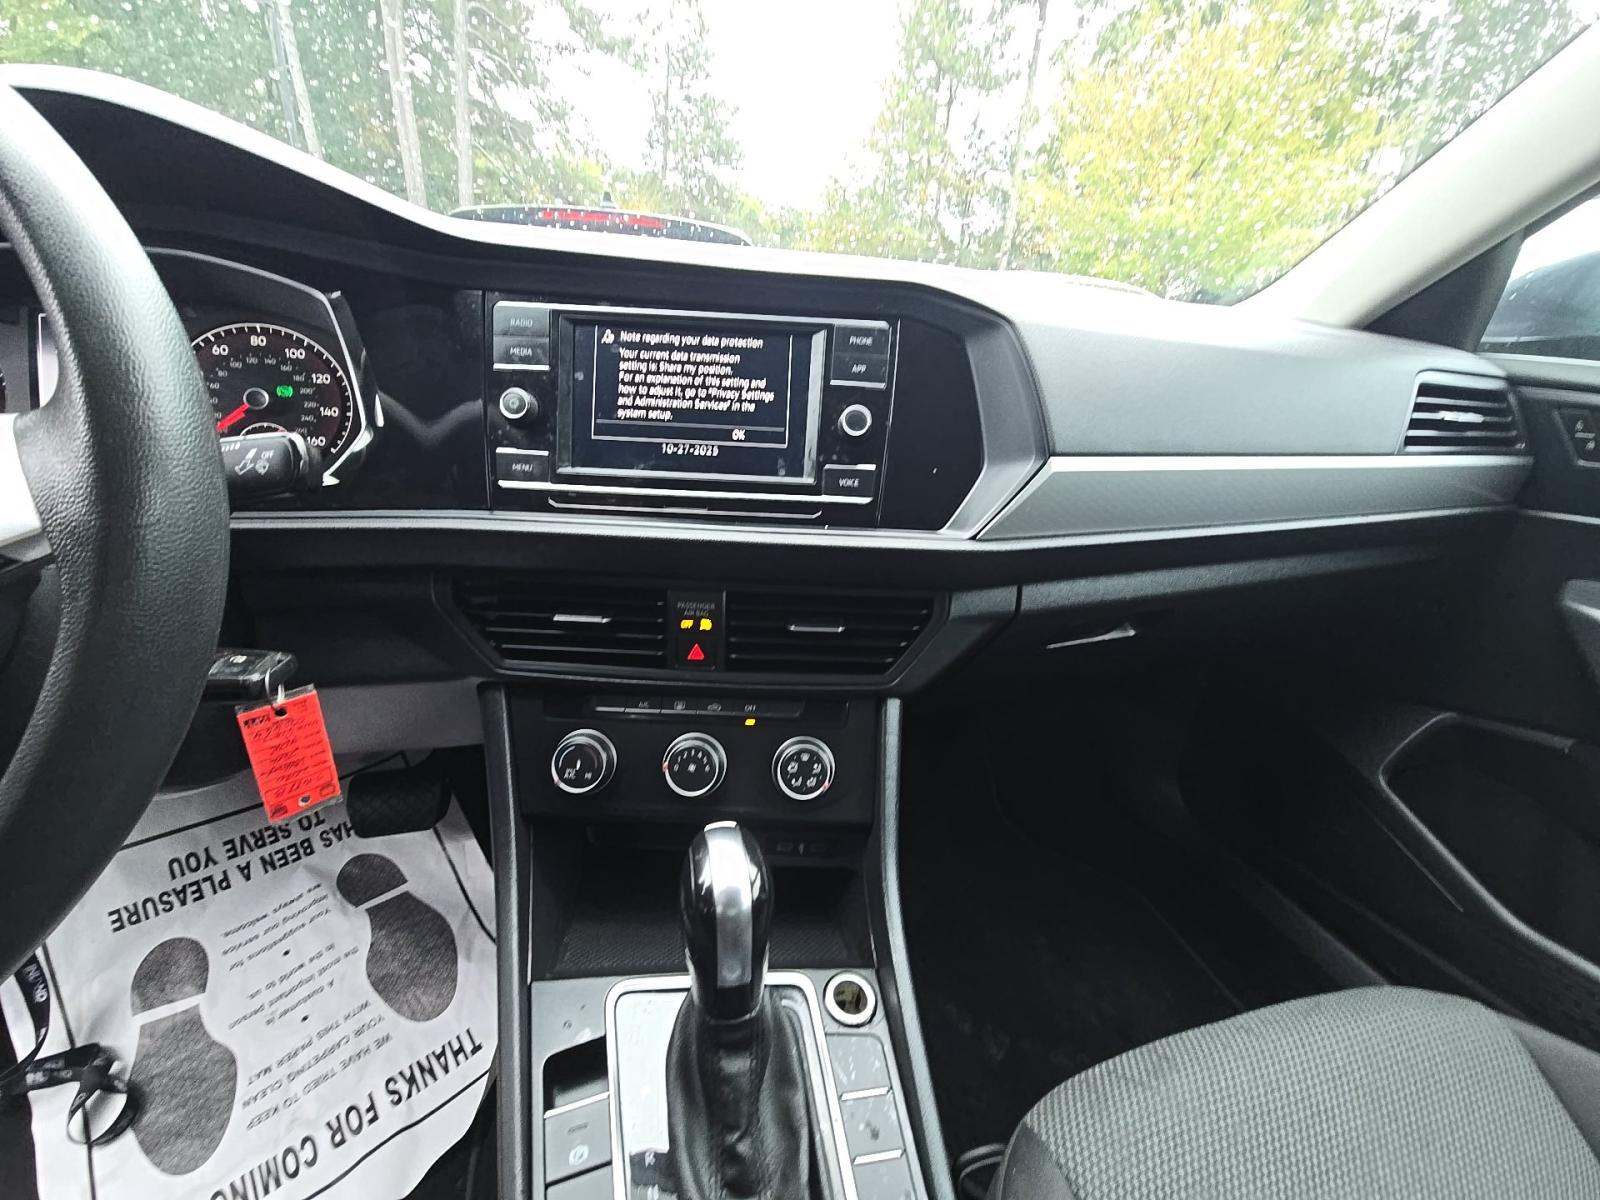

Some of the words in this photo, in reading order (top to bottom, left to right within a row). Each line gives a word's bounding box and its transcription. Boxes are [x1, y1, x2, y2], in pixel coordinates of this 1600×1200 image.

[509, 317, 534, 328] RADIO
[250, 335, 266, 346] 80
[620, 331, 641, 343] Note
[642, 334, 680, 347] regarding
[681, 336, 700, 348] your
[702, 336, 720, 347] data
[720, 336, 764, 349] protection
[848, 335, 873, 346] PHONE
[212, 344, 228, 356] 60
[284, 348, 306, 360] 100
[509, 346, 532, 357] MEDIA
[620, 348, 638, 360] Your
[640, 350, 669, 362] current
[670, 350, 687, 362] data
[690, 351, 740, 364] transmission
[619, 361, 647, 373] setting
[659, 362, 682, 374] Share
[683, 365, 696, 376] my
[850, 364, 867, 374] APP
[312, 374, 330, 384] 120
[619, 371, 632, 382] For
[634, 373, 645, 384] an
[646, 374, 692, 387] explanation
[694, 376, 704, 386] of
[706, 376, 720, 388] this
[721, 377, 750, 390] setting
[750, 378, 766, 390] and
[618, 383, 636, 395] how
[638, 385, 648, 395] to
[649, 385, 674, 398] adjust
[684, 388, 696, 399] go
[698, 387, 707, 398] to
[742, 389, 774, 403] Settings
[320, 406, 338, 417] 140
[617, 396, 633, 407] and
[634, 396, 693, 410] Administration
[732, 400, 740, 412] in
[742, 401, 756, 412] the
[617, 408, 646, 421] system
[307, 436, 326, 446] 160
[731, 428, 746, 440] OK
[661, 443, 719, 457] 10-27-2025
[510, 462, 533, 473] MENU
[838, 477, 860, 488] VOICE
[299, 810, 326, 832] TO
[222, 823, 292, 861] SERVE
[168, 846, 219, 882] YOU
[259, 837, 316, 875] BEEN
[236, 860, 252, 882] A
[107, 870, 232, 933] PLEASURE
[344, 1000, 371, 1022] WITH
[352, 1014, 385, 1038] YOUR
[372, 1032, 392, 1050] WE
[339, 1046, 372, 1072] HAVE
[385, 1027, 484, 1107] THANKS
[302, 1067, 338, 1096] TRIED
[283, 1093, 301, 1110] TO
[247, 1105, 280, 1130] KEEP
[325, 1091, 380, 1150] FOR
